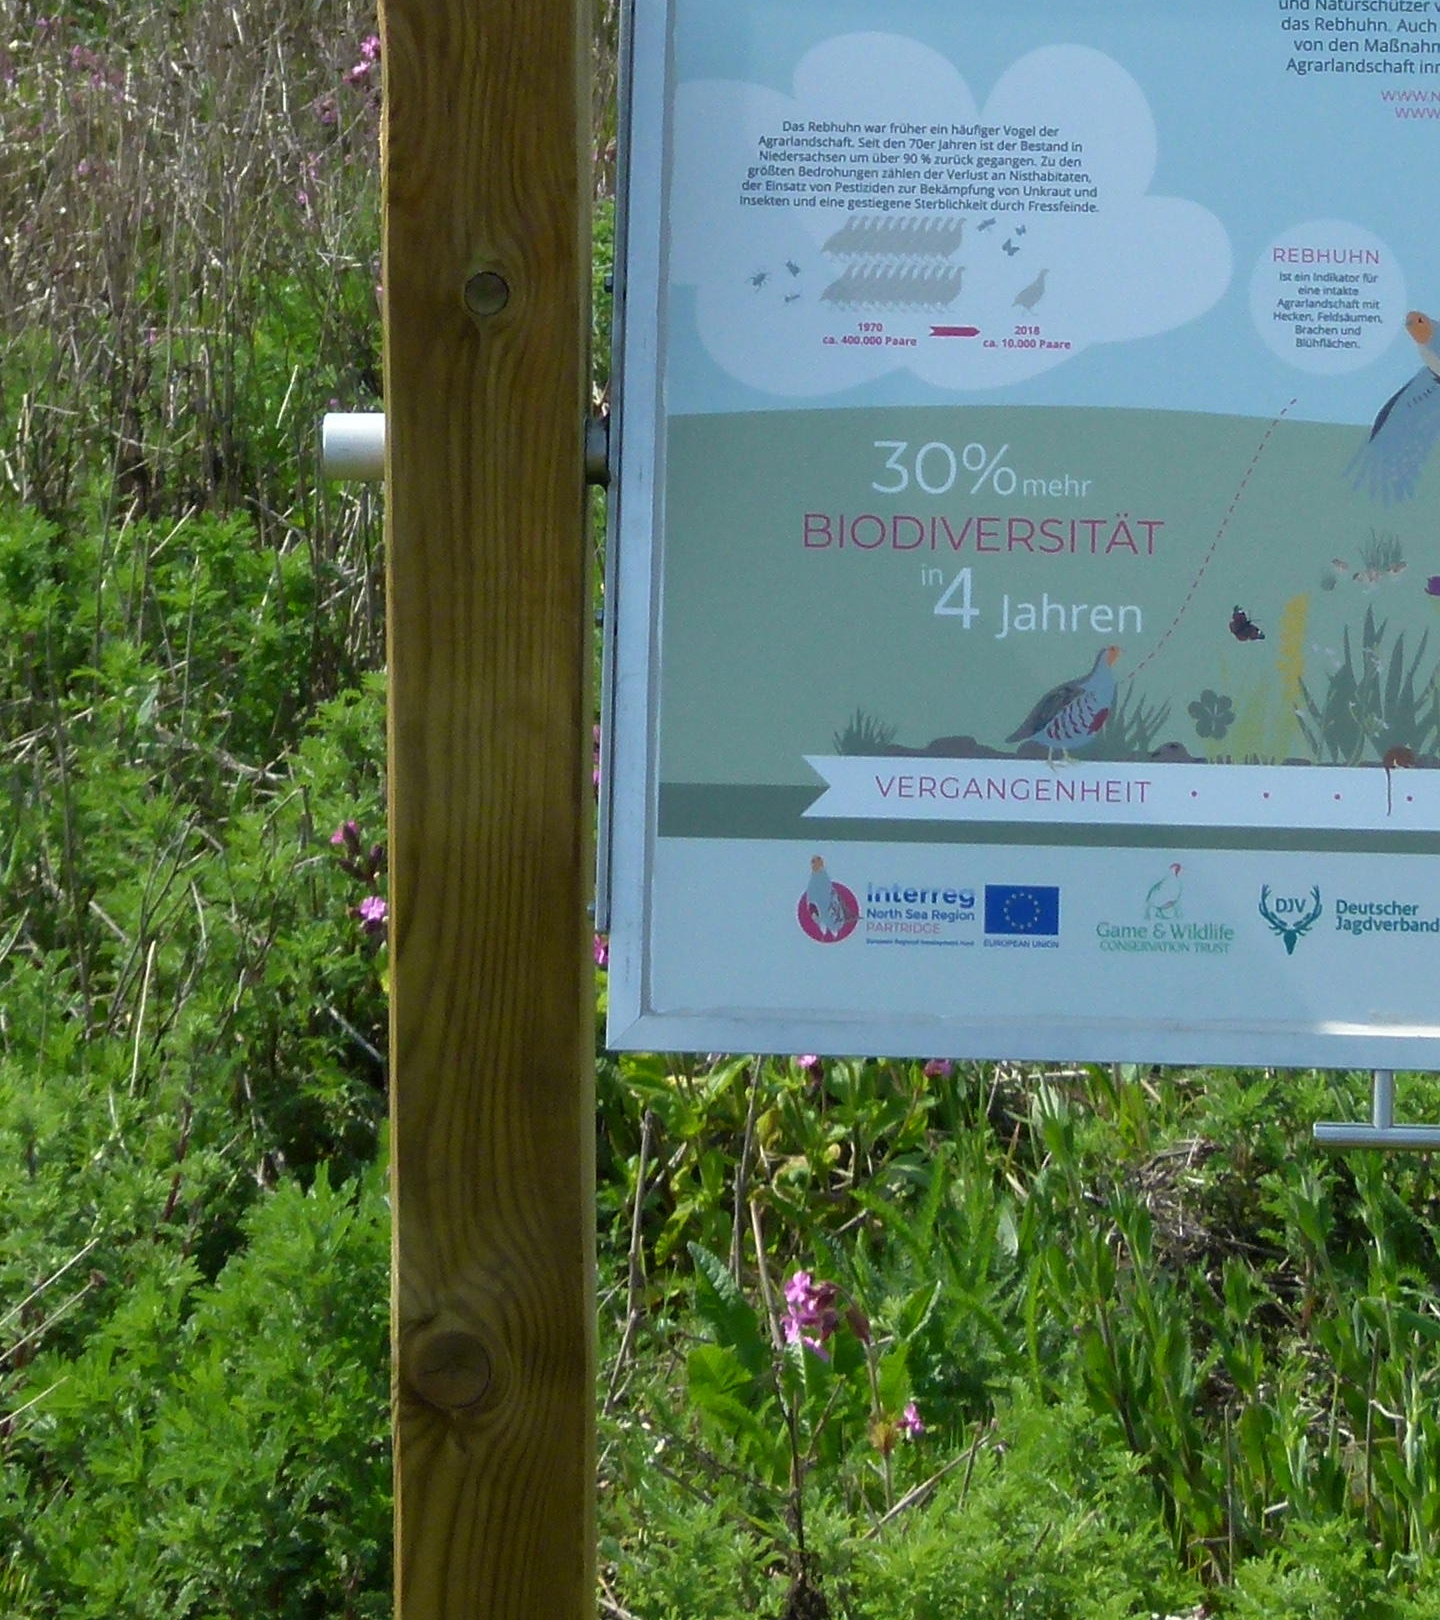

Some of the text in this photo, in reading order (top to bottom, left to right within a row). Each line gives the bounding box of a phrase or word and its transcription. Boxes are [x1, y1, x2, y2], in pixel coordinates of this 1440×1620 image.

[1281, 15, 1309, 30] das
[1314, 16, 1390, 32] Rebhuhn.
[1396, 17, 1436, 33] Auch
[1293, 40, 1323, 51] von
[1328, 37, 1358, 52] den
[1286, 56, 1414, 77] Agrarlandschaft
[782, 120, 1059, 138] Das Rebhuhn war früher ein häufiger Vogel der
[858, 136, 880, 148] Seit
[882, 137, 905, 148] den
[908, 137, 935, 149] 70er
[938, 138, 976, 152] Jahren
[980, 139, 993, 150] ist
[996, 139, 1016, 150] der
[1020, 140, 1068, 151] Bestand
[1071, 141, 1082, 152] in
[759, 150, 846, 162] Niedersachsen
[849, 154, 868, 162] um
[872, 152, 899, 163] über
[903, 152, 917, 163] 90
[920, 153, 931, 164] %
[934, 153, 973, 165] zurück
[1040, 155, 1055, 166] Zu
[1058, 156, 1081, 167] den
[747, 164, 794, 178] größten
[798, 165, 878, 180] Bedrohungen
[881, 167, 920, 178] zählen
[923, 168, 943, 179] der
[946, 168, 988, 180] Verlust
[991, 172, 1005, 180] an
[741, 179, 1097, 197] der Einsatz von Pestiziden zur Bekämpfung von Unkraut und
[739, 194, 790, 206] Insekten
[793, 195, 816, 206] und
[819, 196, 844, 207] eine
[848, 196, 910, 211] gestiegene
[914, 197, 987, 210] Sterblichkeit
[990, 199, 1024, 210] durch
[1279, 271, 1379, 282] Ist ein Indikator für
[1297, 284, 1359, 295] eine intakte
[1276, 297, 1380, 311] Agrarlandschaft mit
[857, 321, 883, 331] 1970
[1014, 324, 1040, 334] 2018
[1294, 324, 1361, 335] Brachen und
[840, 334, 882, 345] 400.000
[885, 335, 917, 345] Paare
[1001, 338, 1036, 348] 10.000
[1039, 338, 1071, 349] Paare
[871, 440, 1092, 498] 30% mehr
[802, 512, 1165, 555] BIODIVERSITÄT
[921, 564, 1142, 639] in 4 Jahren
[875, 775, 1151, 803] VERGANGENHEIT
[1275, 898, 1307, 913] DJV
[1335, 899, 1419, 916] Deutscher
[866, 908, 975, 923] North Sea Region
[866, 921, 941, 934] PARTRIDGE
[1096, 922, 1148, 939] Game
[1169, 923, 1235, 940] Wildlife
[1335, 915, 1440, 935] Jagdverband
[983, 938, 1030, 947] EUROPEAN
